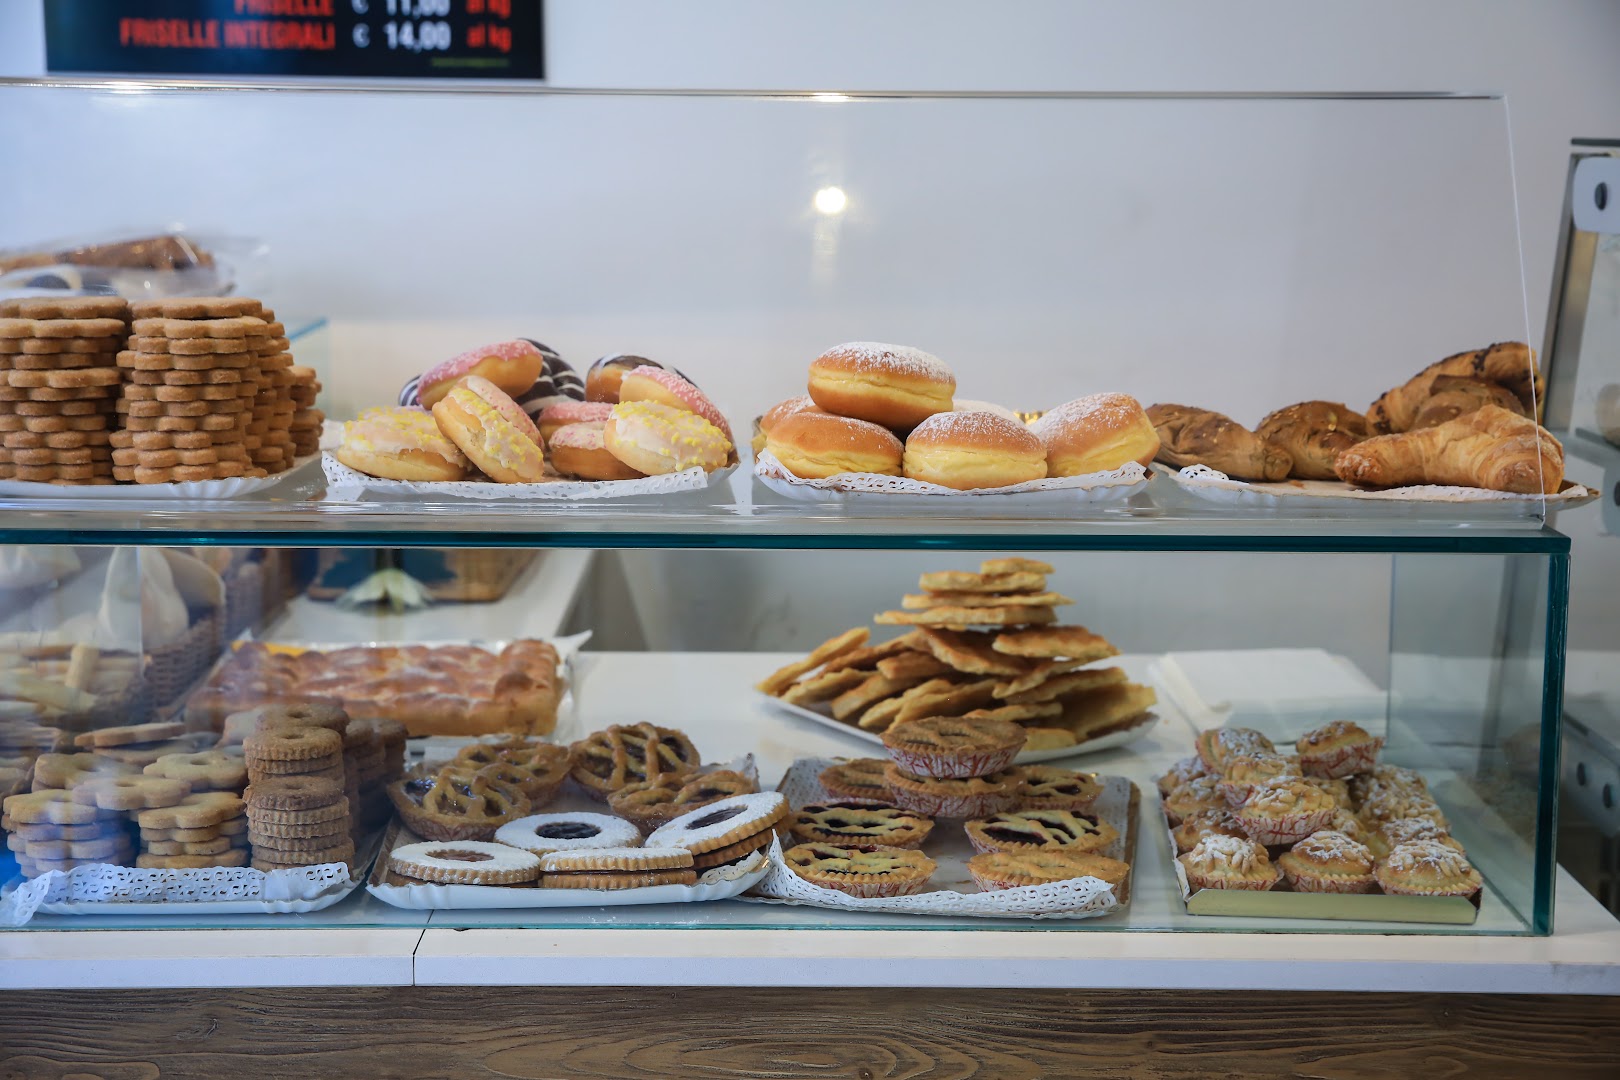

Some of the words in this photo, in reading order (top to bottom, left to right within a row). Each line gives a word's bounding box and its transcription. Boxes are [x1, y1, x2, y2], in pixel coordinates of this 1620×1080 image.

[120, 18, 219, 47] FRISELLE
[224, 21, 335, 48] INTEGRALI
[383, 21, 451, 53] 14,00
[488, 23, 512, 53] kg
